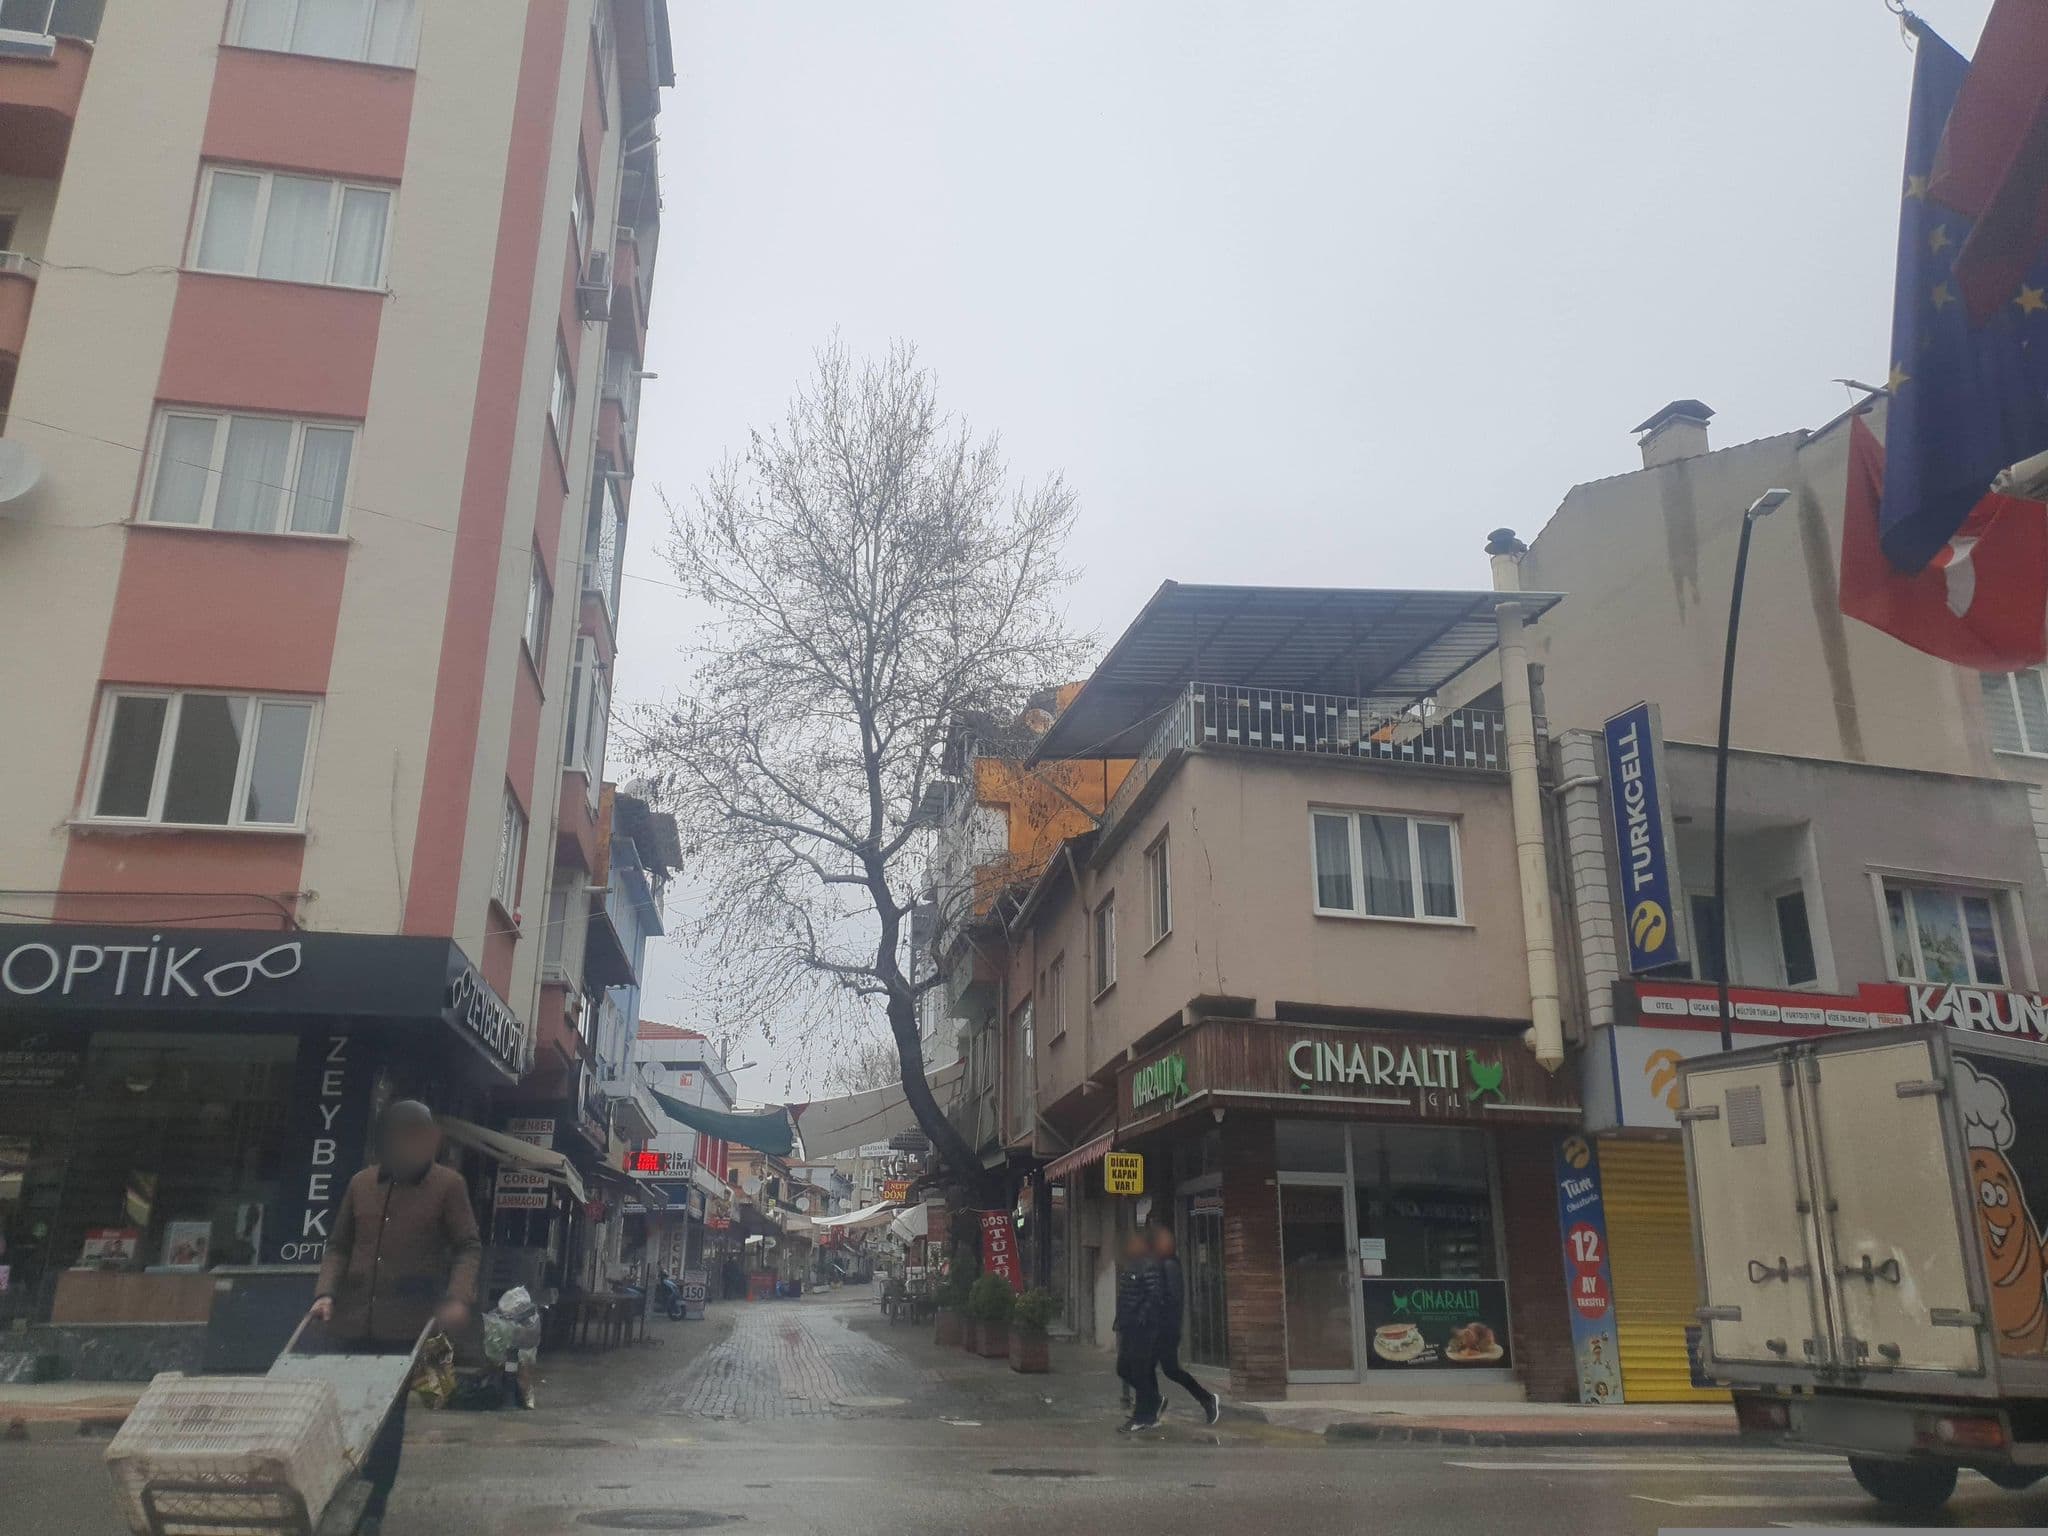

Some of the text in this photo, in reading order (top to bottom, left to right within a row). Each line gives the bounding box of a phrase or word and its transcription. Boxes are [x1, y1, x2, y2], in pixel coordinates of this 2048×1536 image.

[1619, 722, 1653, 891] TURKCELL
[2, 934, 201, 997] OPTİK
[1656, 1002, 1674, 1010] OTEL
[467, 985, 505, 1052] ZEYBEK
[303, 1037, 348, 1236] ZEYBEK
[1110, 1157, 1139, 1168] DİKKAT
[1112, 1169, 1138, 1179] KAPAN
[981, 1215, 1009, 1227] DOST
[280, 1240, 327, 1261] OPTİ
[1571, 1231, 1600, 1262] 12
[685, 1287, 704, 1298] 150
[1582, 1276, 1597, 1293] AY
